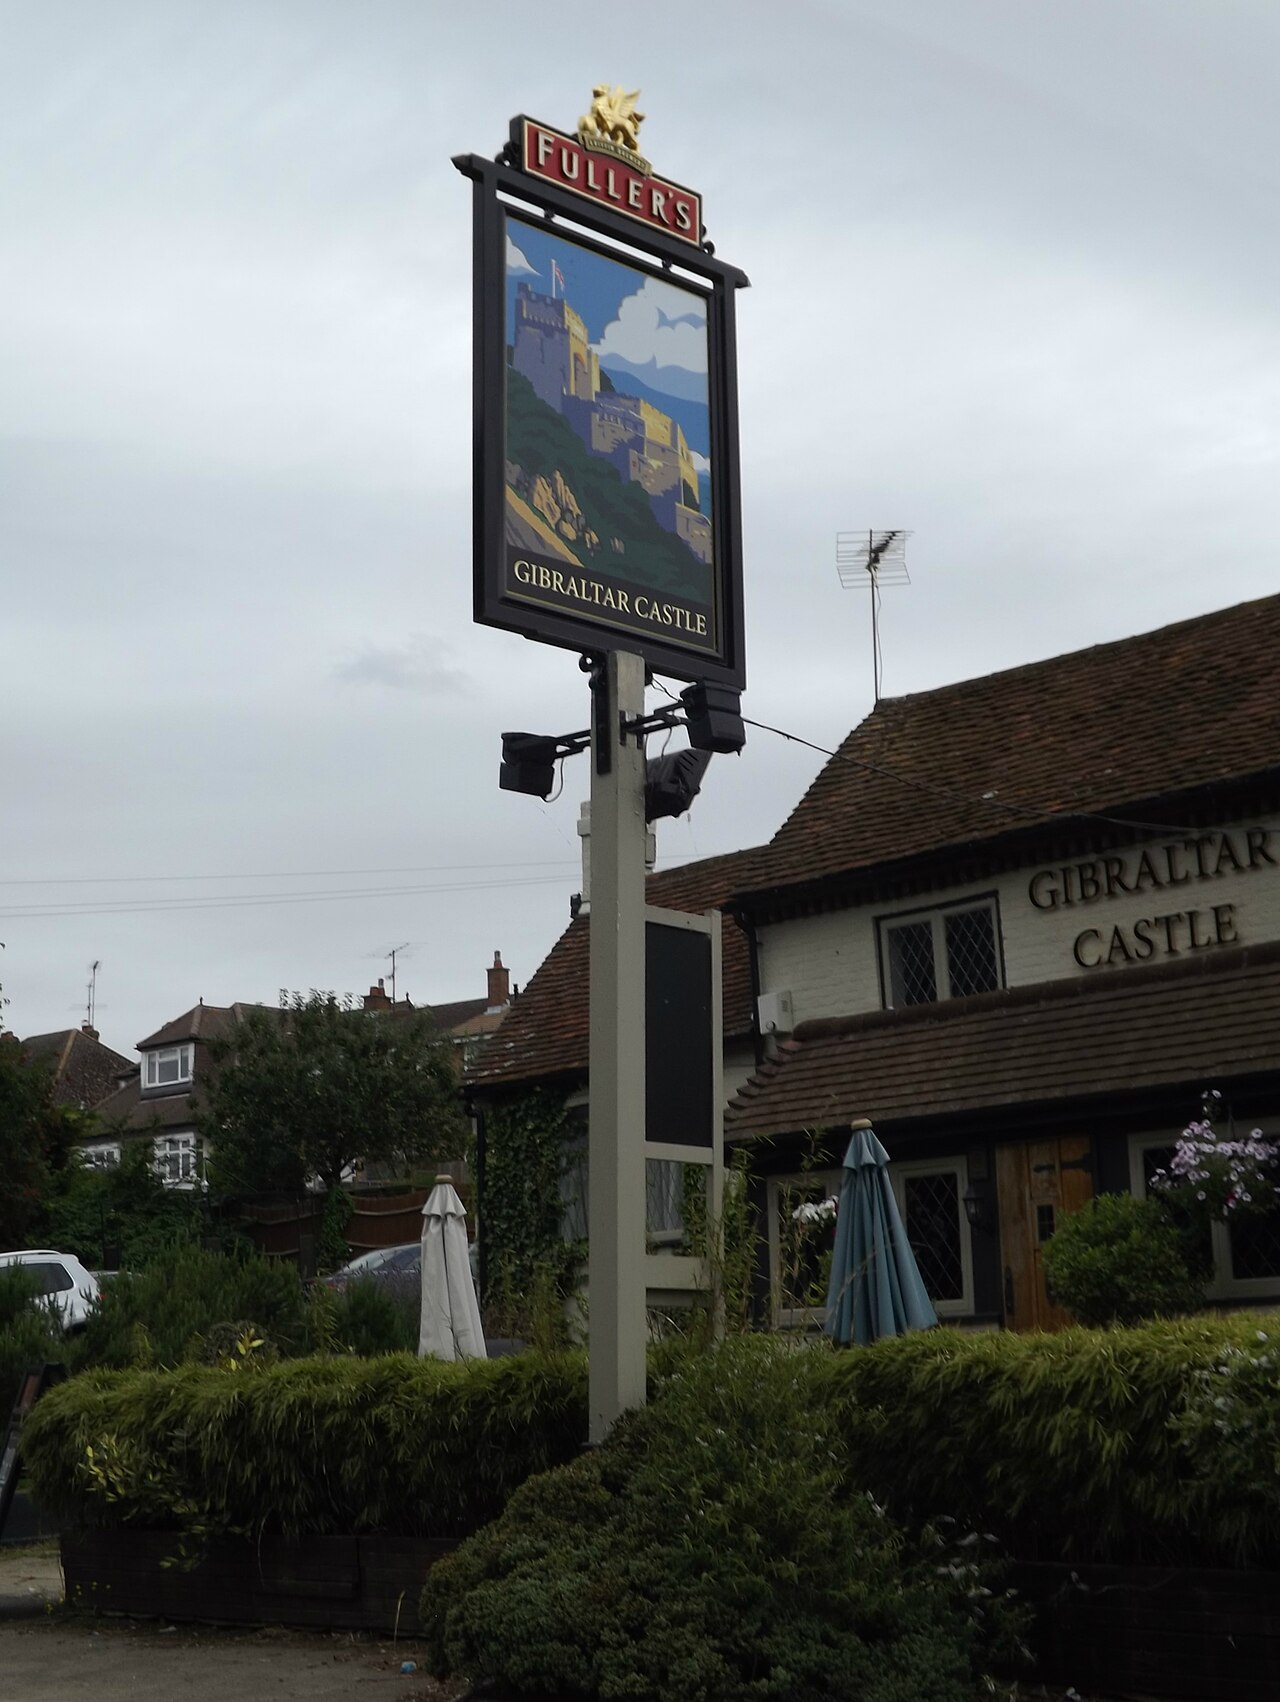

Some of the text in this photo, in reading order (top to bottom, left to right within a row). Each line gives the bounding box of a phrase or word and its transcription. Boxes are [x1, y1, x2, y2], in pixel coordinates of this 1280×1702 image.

[536, 130, 691, 231] FULLER'S
[514, 560, 707, 636] GIBRALTAR CASTLE
[1029, 827, 1275, 910] GIBRALTAR
[1073, 903, 1238, 968] CASTLE
